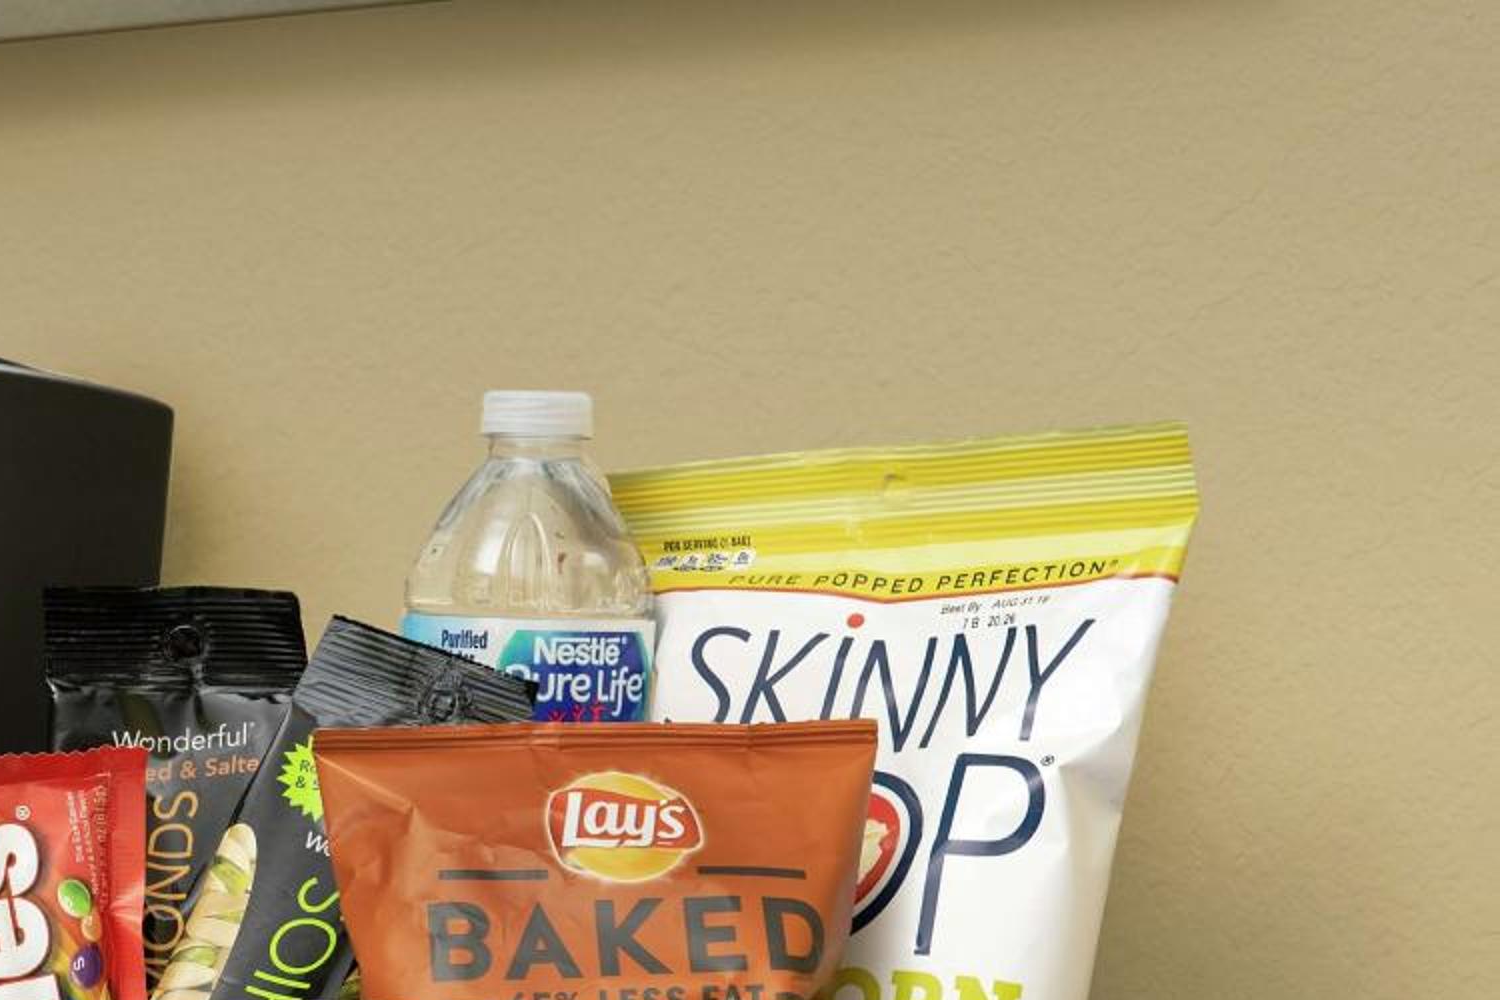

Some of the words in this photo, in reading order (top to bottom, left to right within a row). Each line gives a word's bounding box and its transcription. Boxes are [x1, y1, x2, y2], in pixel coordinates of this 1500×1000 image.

[814, 572, 923, 594] POPPED
[441, 629, 489, 649] Purified
[597, 666, 644, 717] Life
[180, 761, 198, 779] &
[205, 756, 260, 777] Salte
[563, 789, 685, 849] Lay's
[428, 895, 824, 984] BAKED
